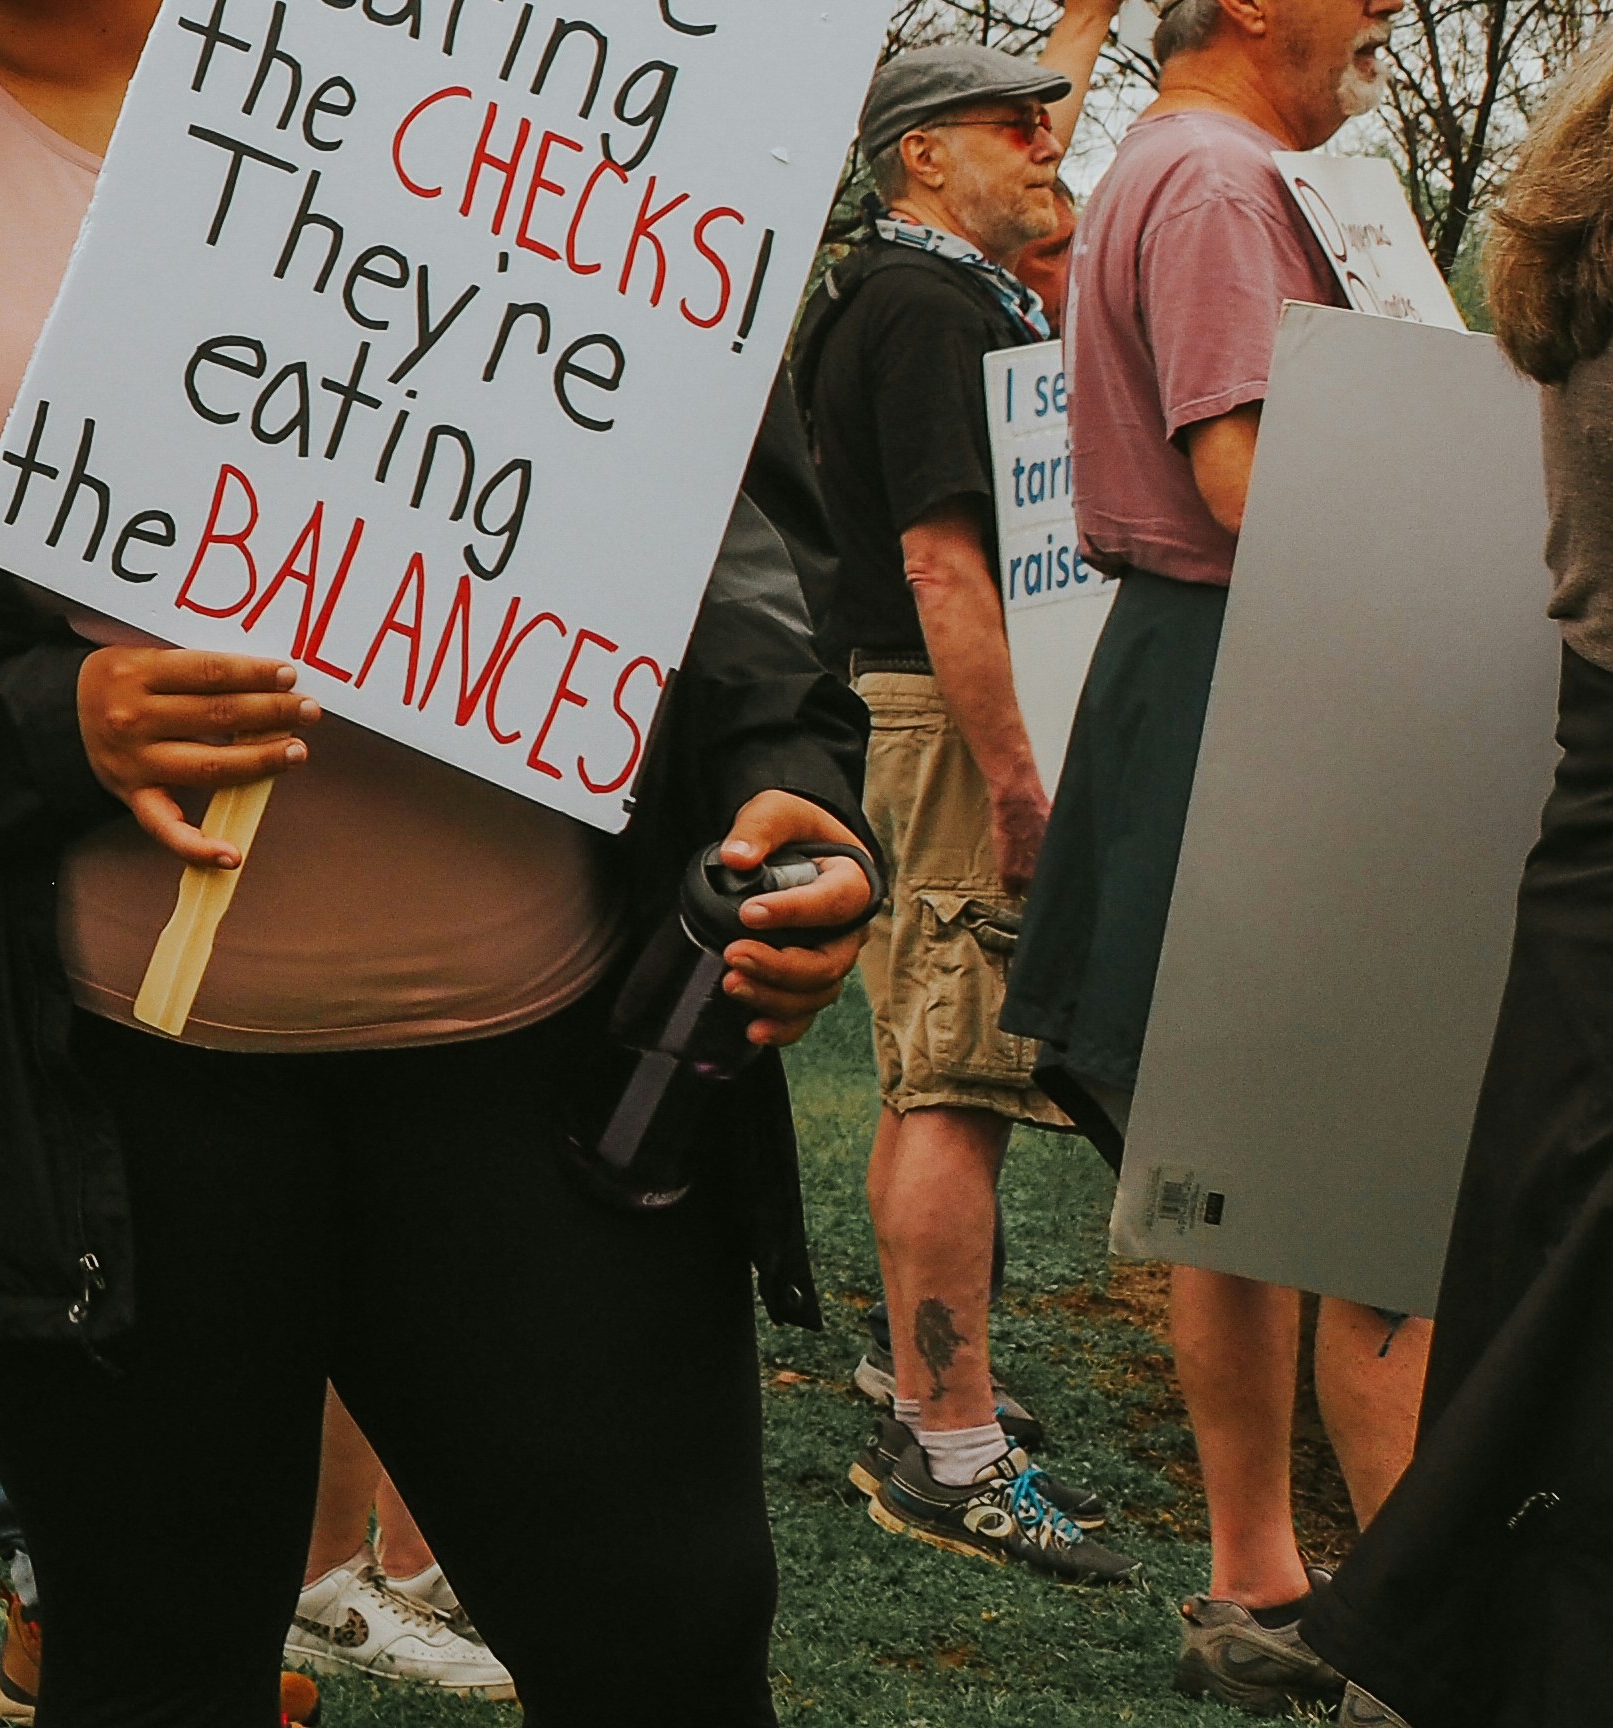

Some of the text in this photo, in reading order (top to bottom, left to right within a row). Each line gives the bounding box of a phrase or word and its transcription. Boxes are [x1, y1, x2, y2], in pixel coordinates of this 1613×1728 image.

[187, 123, 626, 432] They're
[391, 86, 776, 354] CHECKS!
[2, 398, 177, 584] the
[183, 333, 532, 581] eating
[1005, 367, 1014, 423] I
